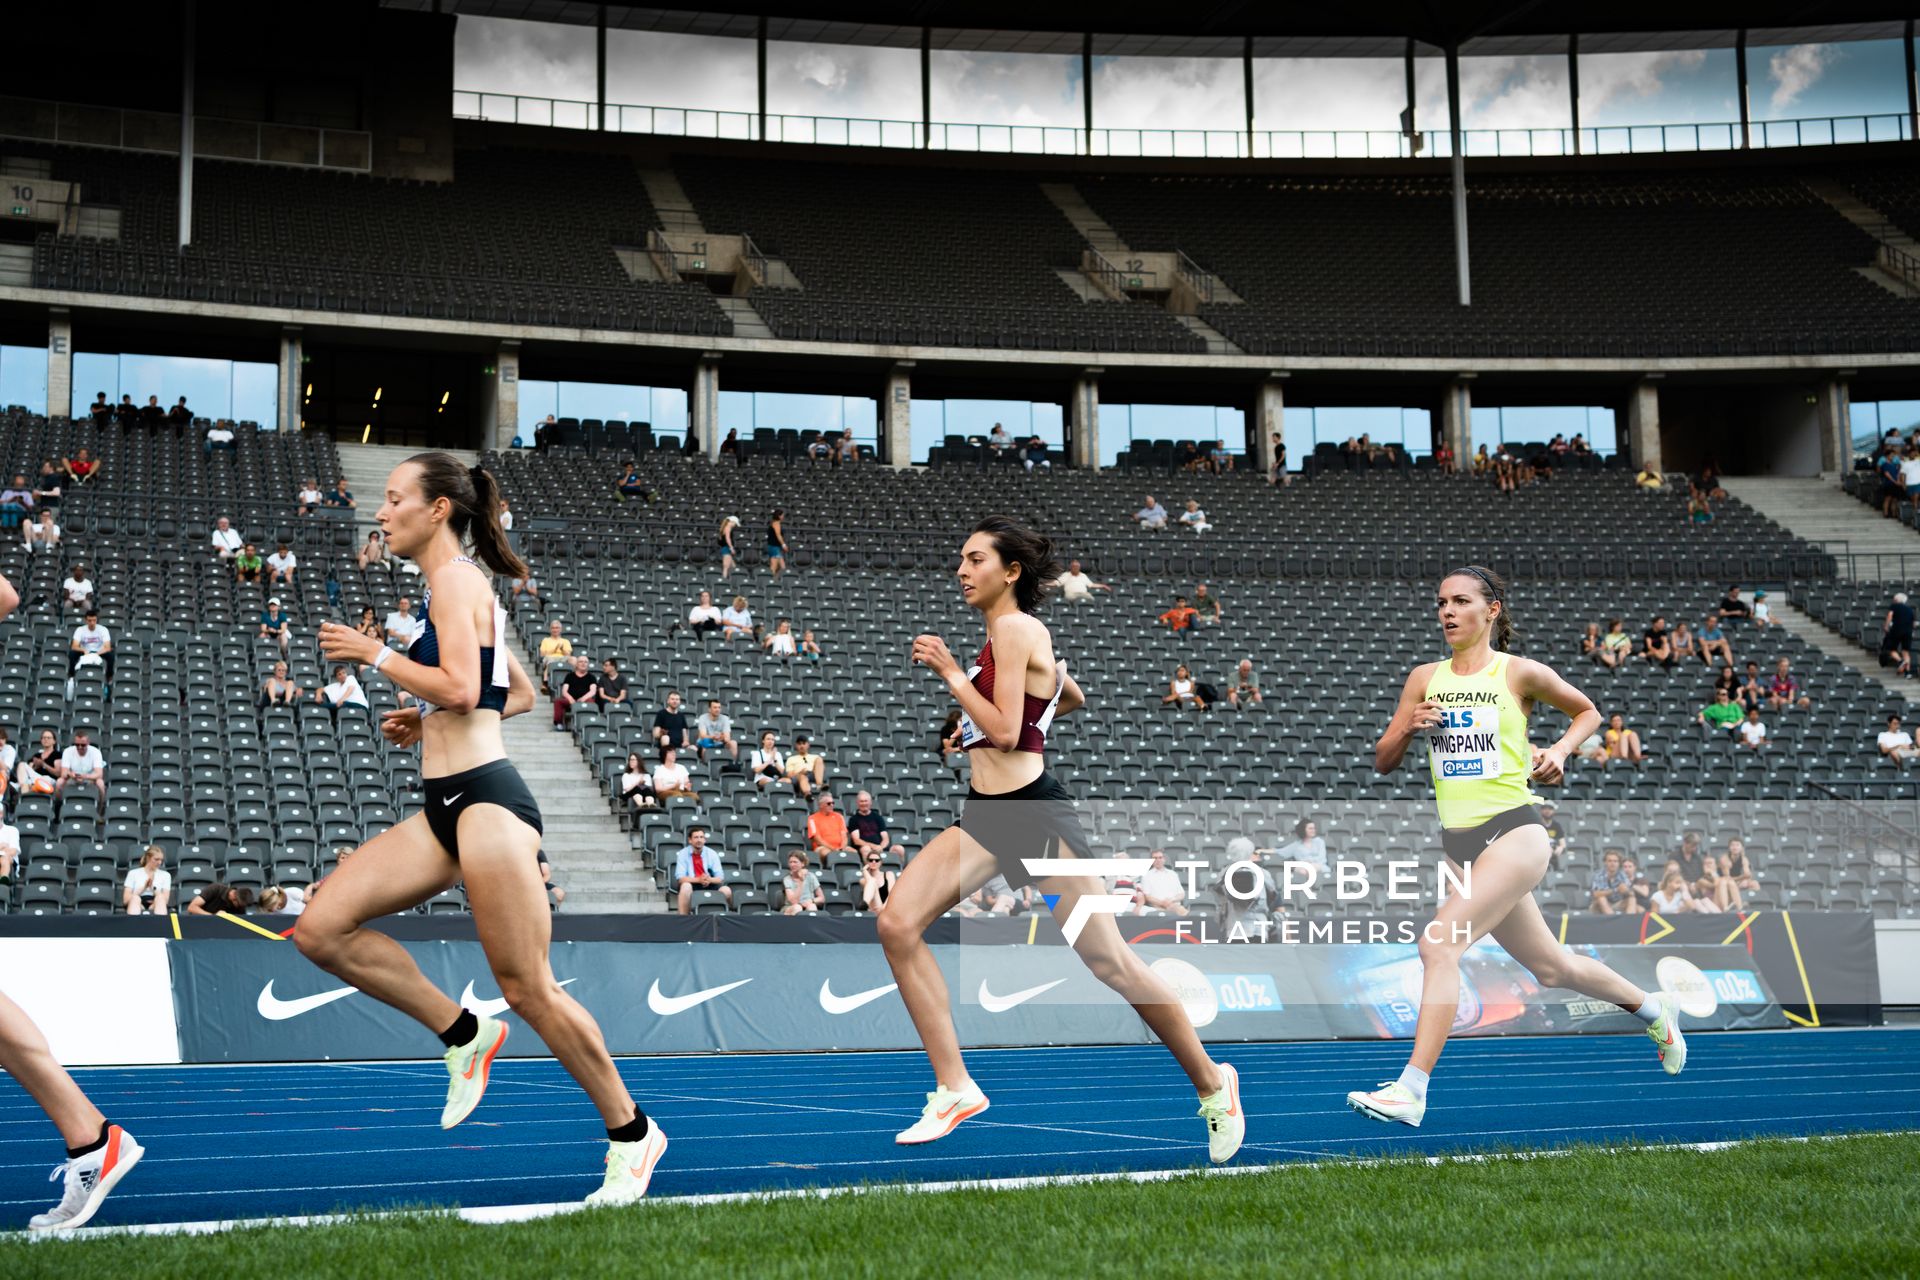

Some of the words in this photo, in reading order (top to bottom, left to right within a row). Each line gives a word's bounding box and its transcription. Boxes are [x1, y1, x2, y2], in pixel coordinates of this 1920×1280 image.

[11, 186, 33, 201] 10
[691, 241, 707, 255] 11
[1125, 259, 1143, 273] 12
[53, 336, 67, 353] E
[502, 366, 515, 383] E
[896, 387, 907, 403] E
[1431, 734, 1496, 753] PINGPANK
[1456, 762, 1481, 770] PLAN
